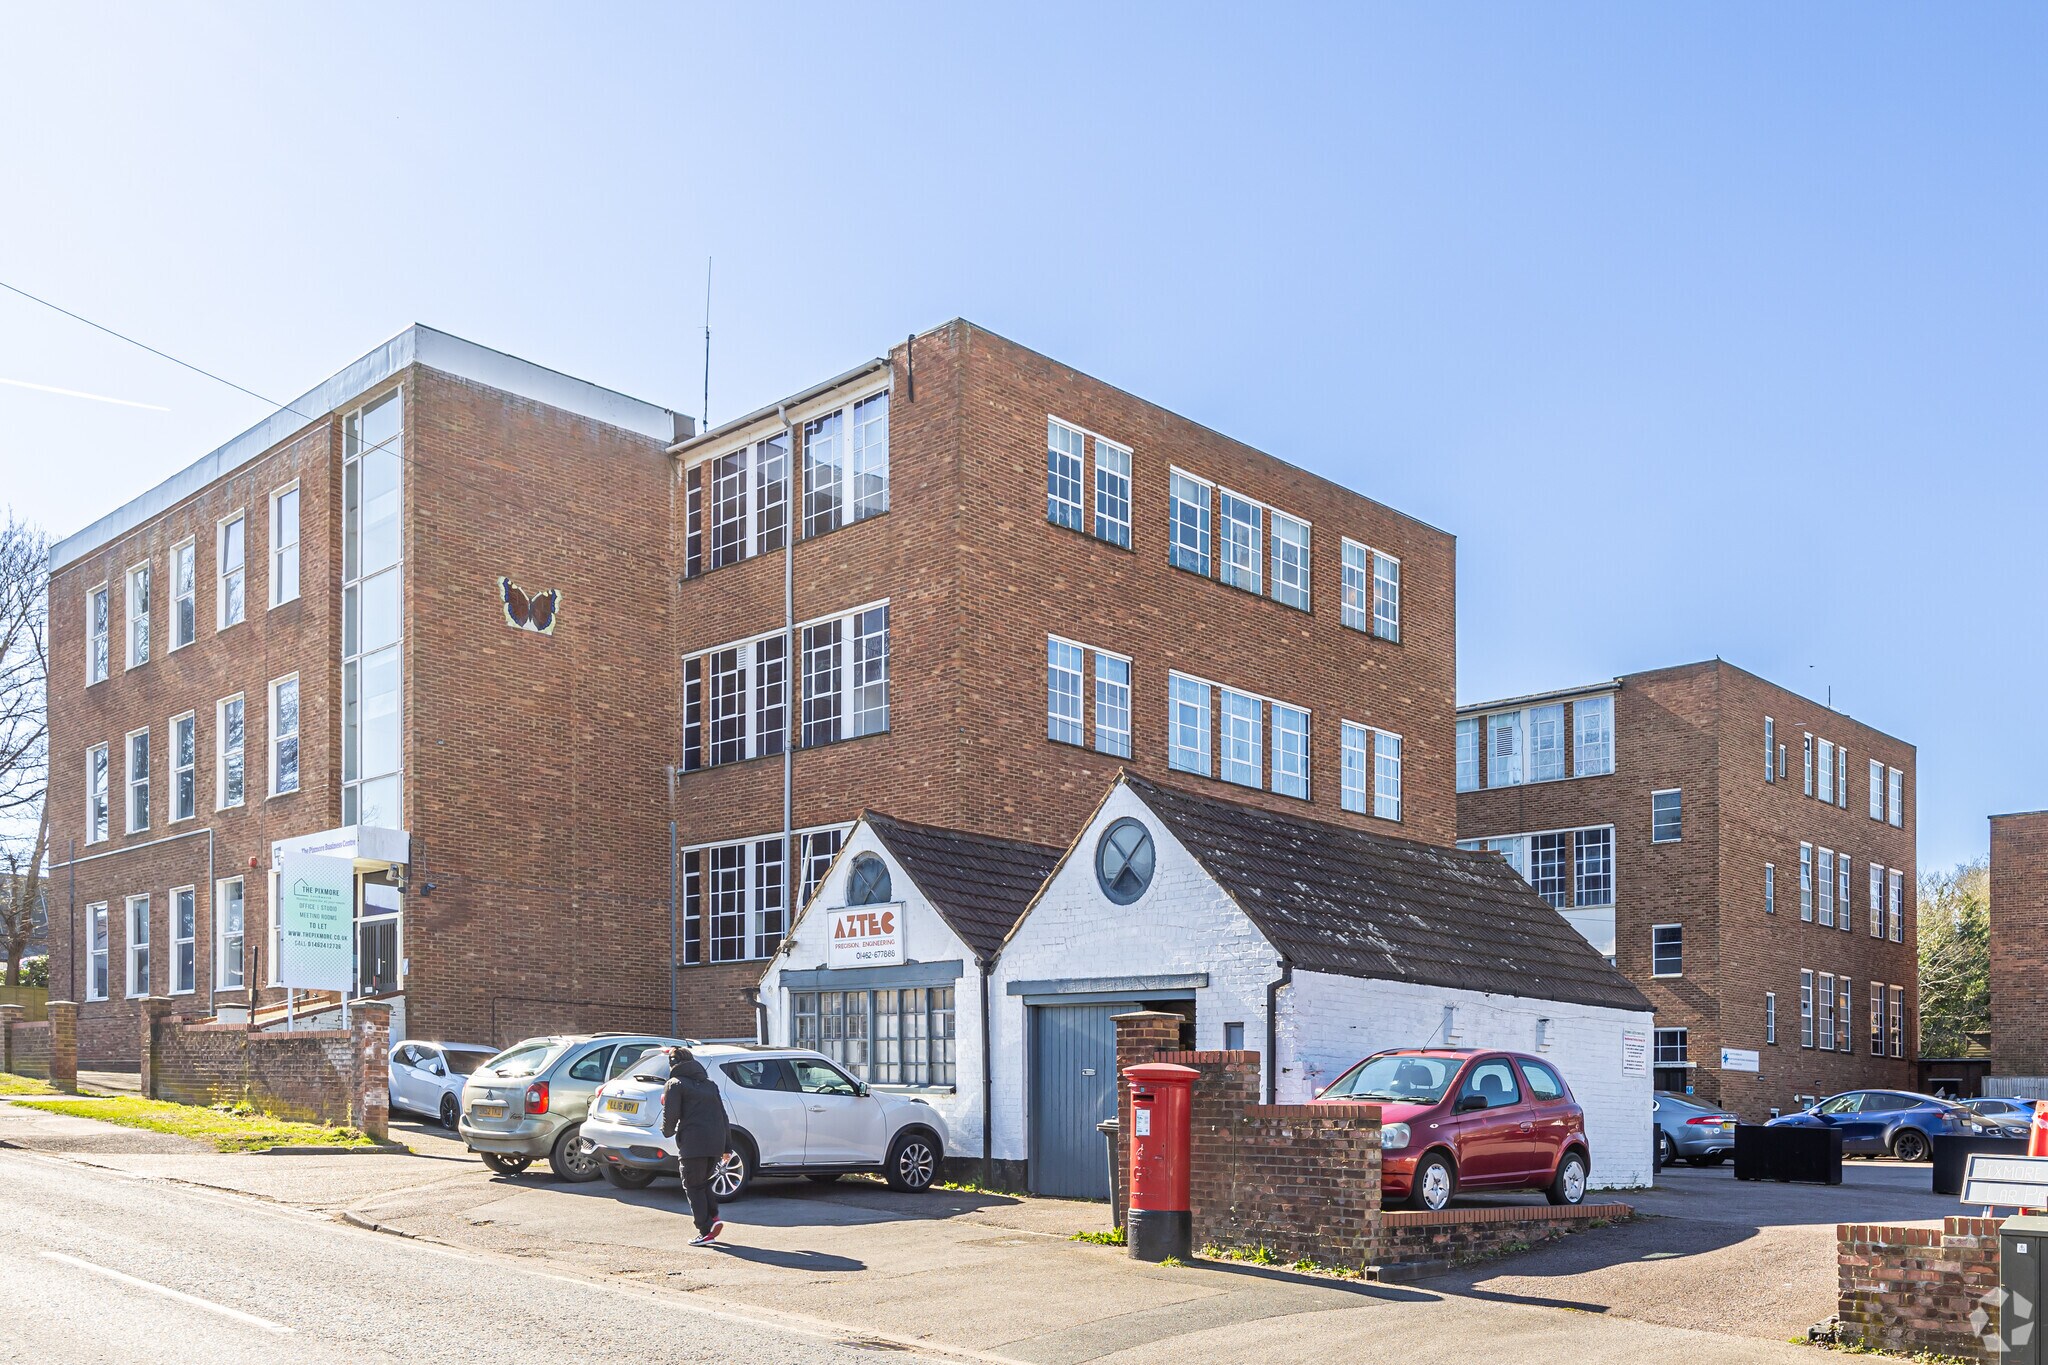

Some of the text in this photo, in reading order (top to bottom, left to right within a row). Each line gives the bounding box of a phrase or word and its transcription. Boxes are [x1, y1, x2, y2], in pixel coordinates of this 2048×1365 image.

[325, 841, 343, 850] Business
[299, 902, 315, 910] OFFICE
[321, 904, 338, 912] STUDIO
[299, 911, 320, 920] MEETING
[834, 911, 895, 938] AZTEC
[862, 939, 895, 947] ENGINEERING
[1975, 1159, 2042, 1180] PIXMORE
